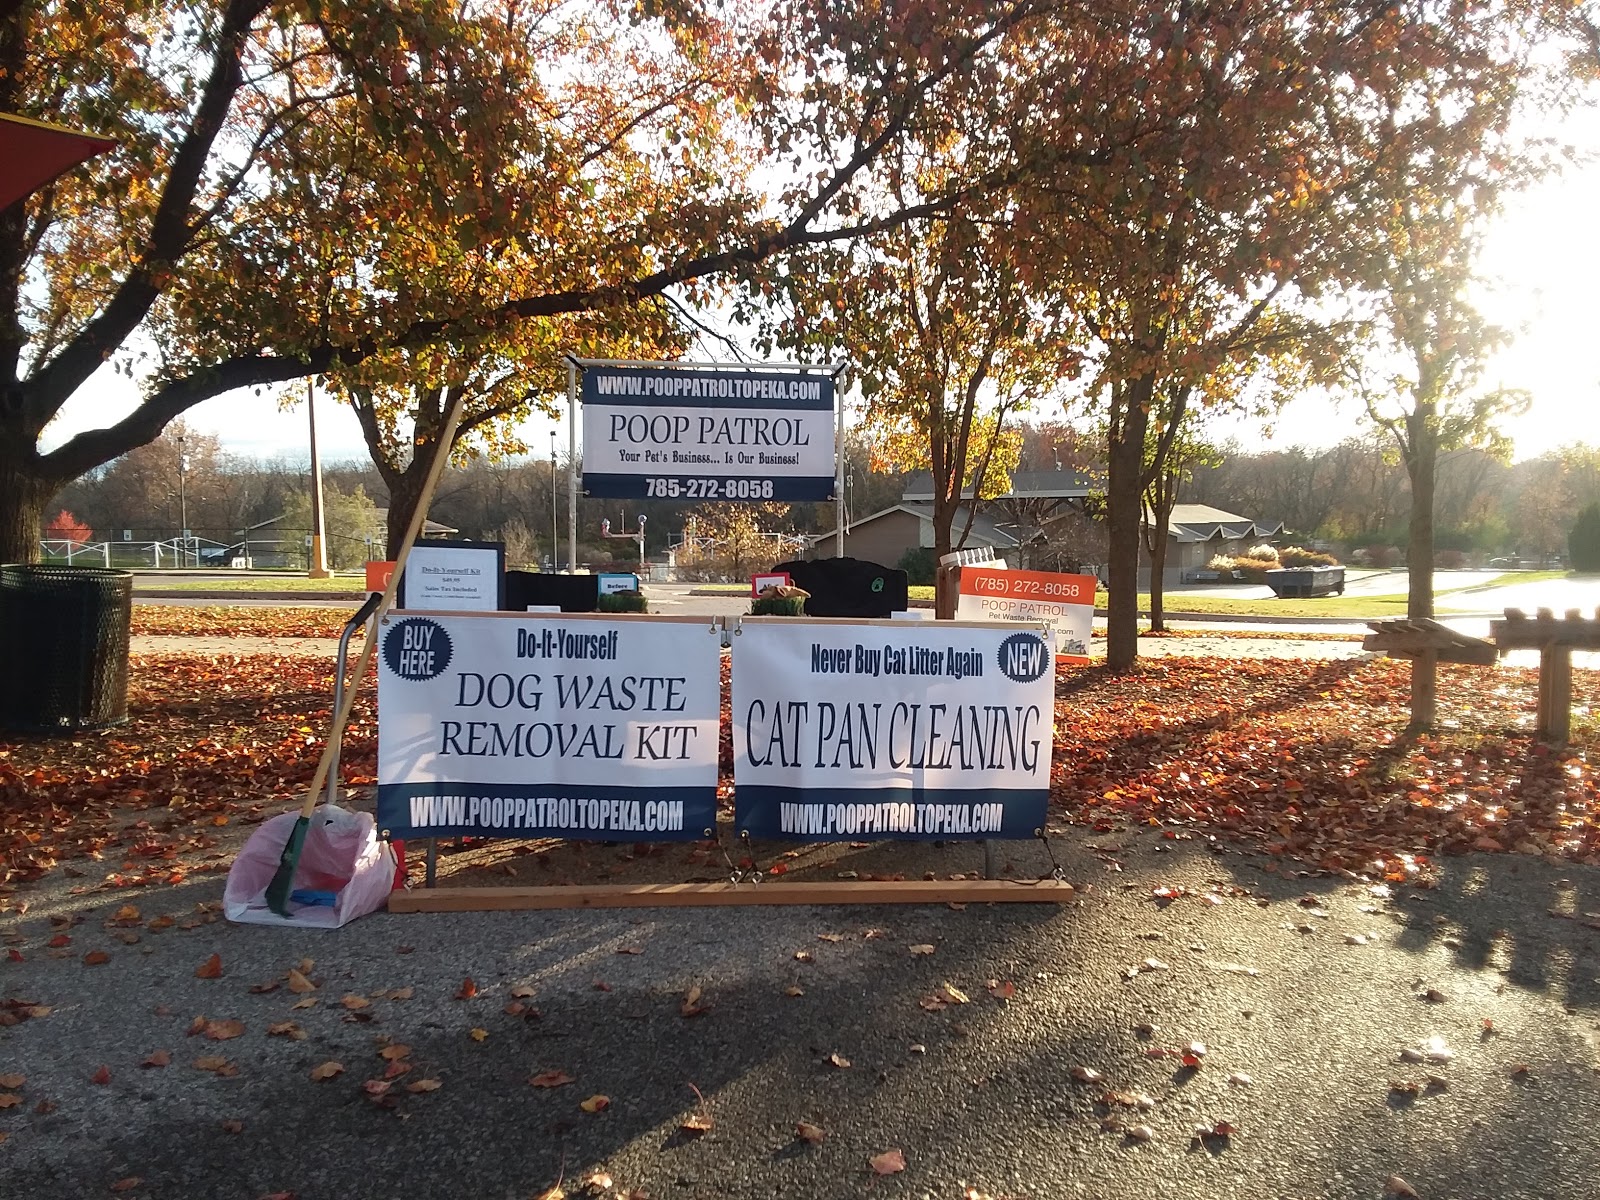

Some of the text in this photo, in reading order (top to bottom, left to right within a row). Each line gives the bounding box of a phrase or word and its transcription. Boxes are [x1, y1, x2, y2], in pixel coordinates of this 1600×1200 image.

[596, 375, 821, 400] WWW.POOPPATROLTOPEKA.COM
[608, 414, 811, 446] POOP PATROL
[619, 449, 800, 465] Your Pet's Business... Is Our Business!
[645, 478, 774, 499] 785-272-8058
[974, 576, 1080, 597] (785) 272-8058
[981, 599, 1068, 617] POOP PATROL
[988, 611, 1001, 620] Pet
[1003, 613, 1025, 622] Waste
[403, 625, 436, 649] BUY
[517, 628, 619, 660] Do-It-Yourself
[399, 650, 436, 676] HERE
[811, 643, 983, 680] Never Buy Cat Litter Again
[1007, 642, 1042, 677] NEW
[454, 672, 687, 712] DOG WASTE
[439, 721, 698, 761] REMOVAL KIT
[746, 699, 1041, 776] CAT PAN CLEANING
[410, 796, 684, 831] WWW.POOPPATROLTOPEKA.COM
[780, 802, 1003, 834] WWW.POOPPATROLTOPEKA.COM
